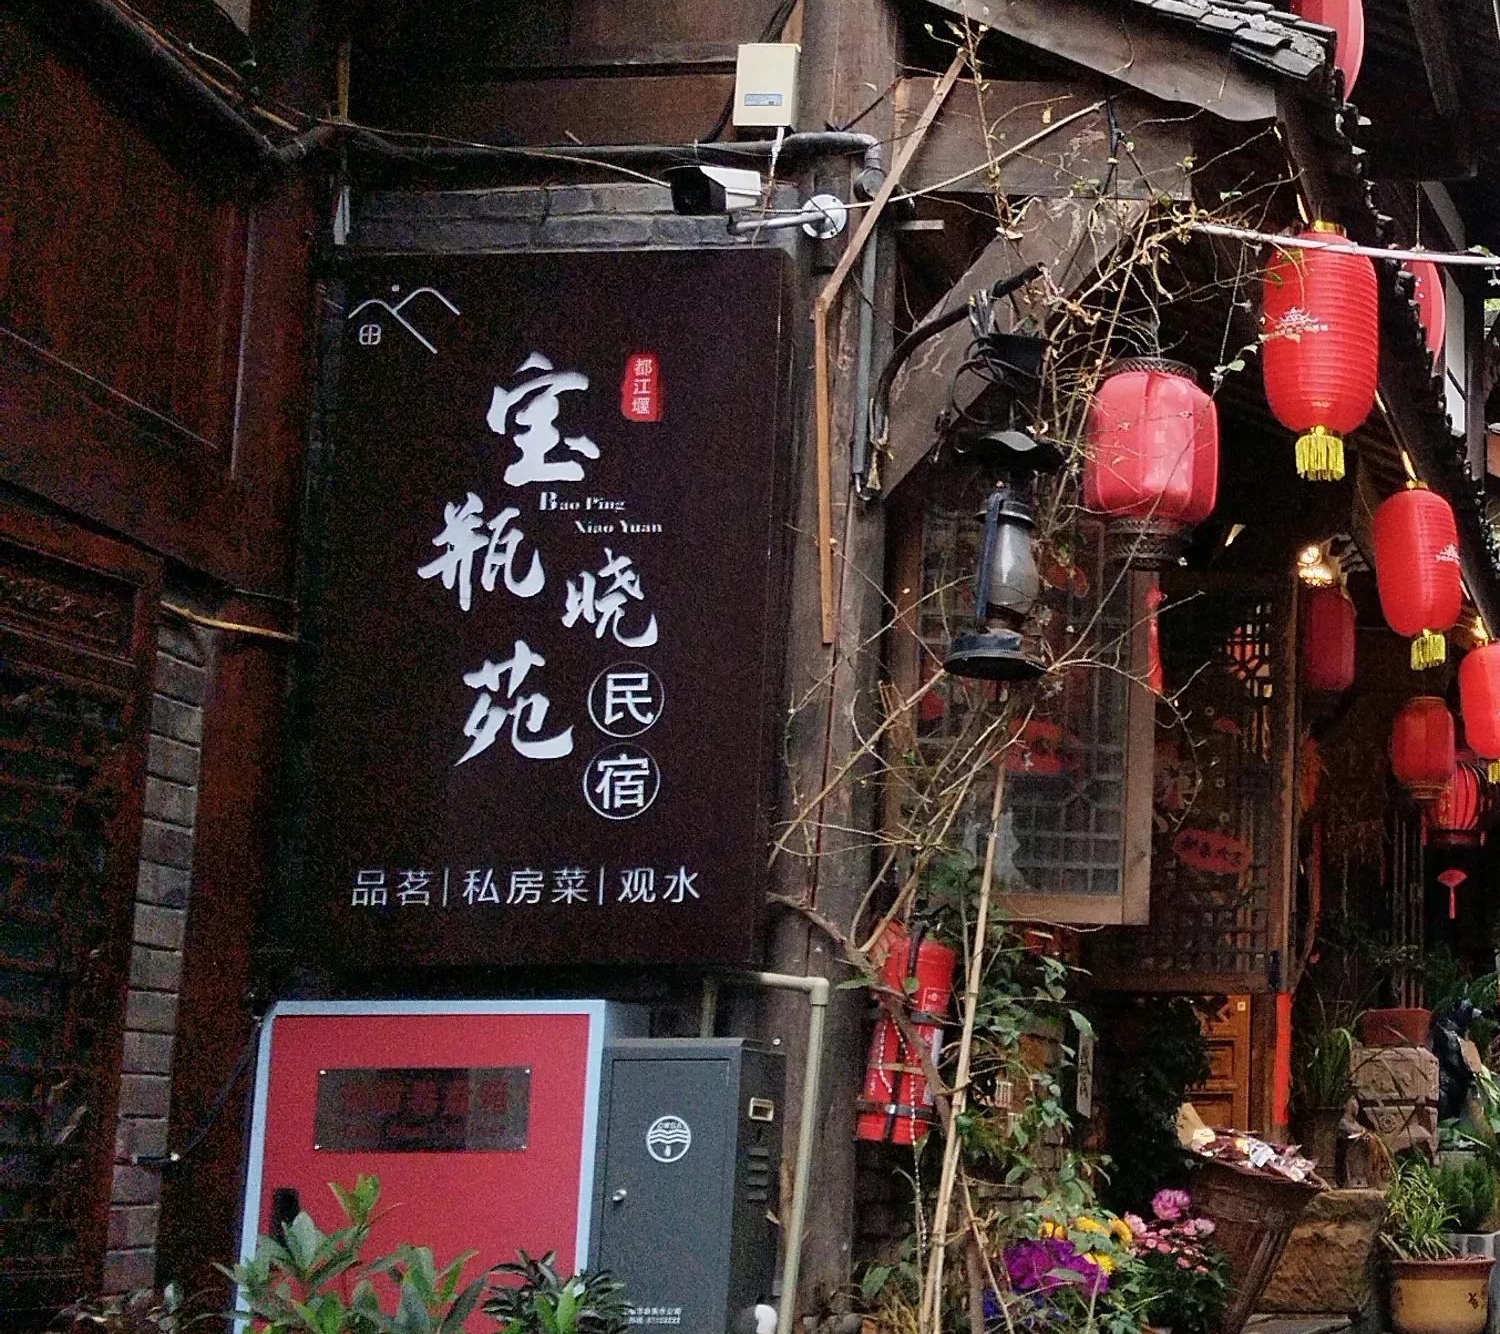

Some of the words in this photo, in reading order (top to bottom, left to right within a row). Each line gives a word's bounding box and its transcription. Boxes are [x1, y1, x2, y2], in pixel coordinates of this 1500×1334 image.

[632, 357, 655, 416] 都江堰
[540, 491, 580, 512] Bao
[619, 518, 663, 534] Yuan
[590, 663, 664, 819] 民宿
